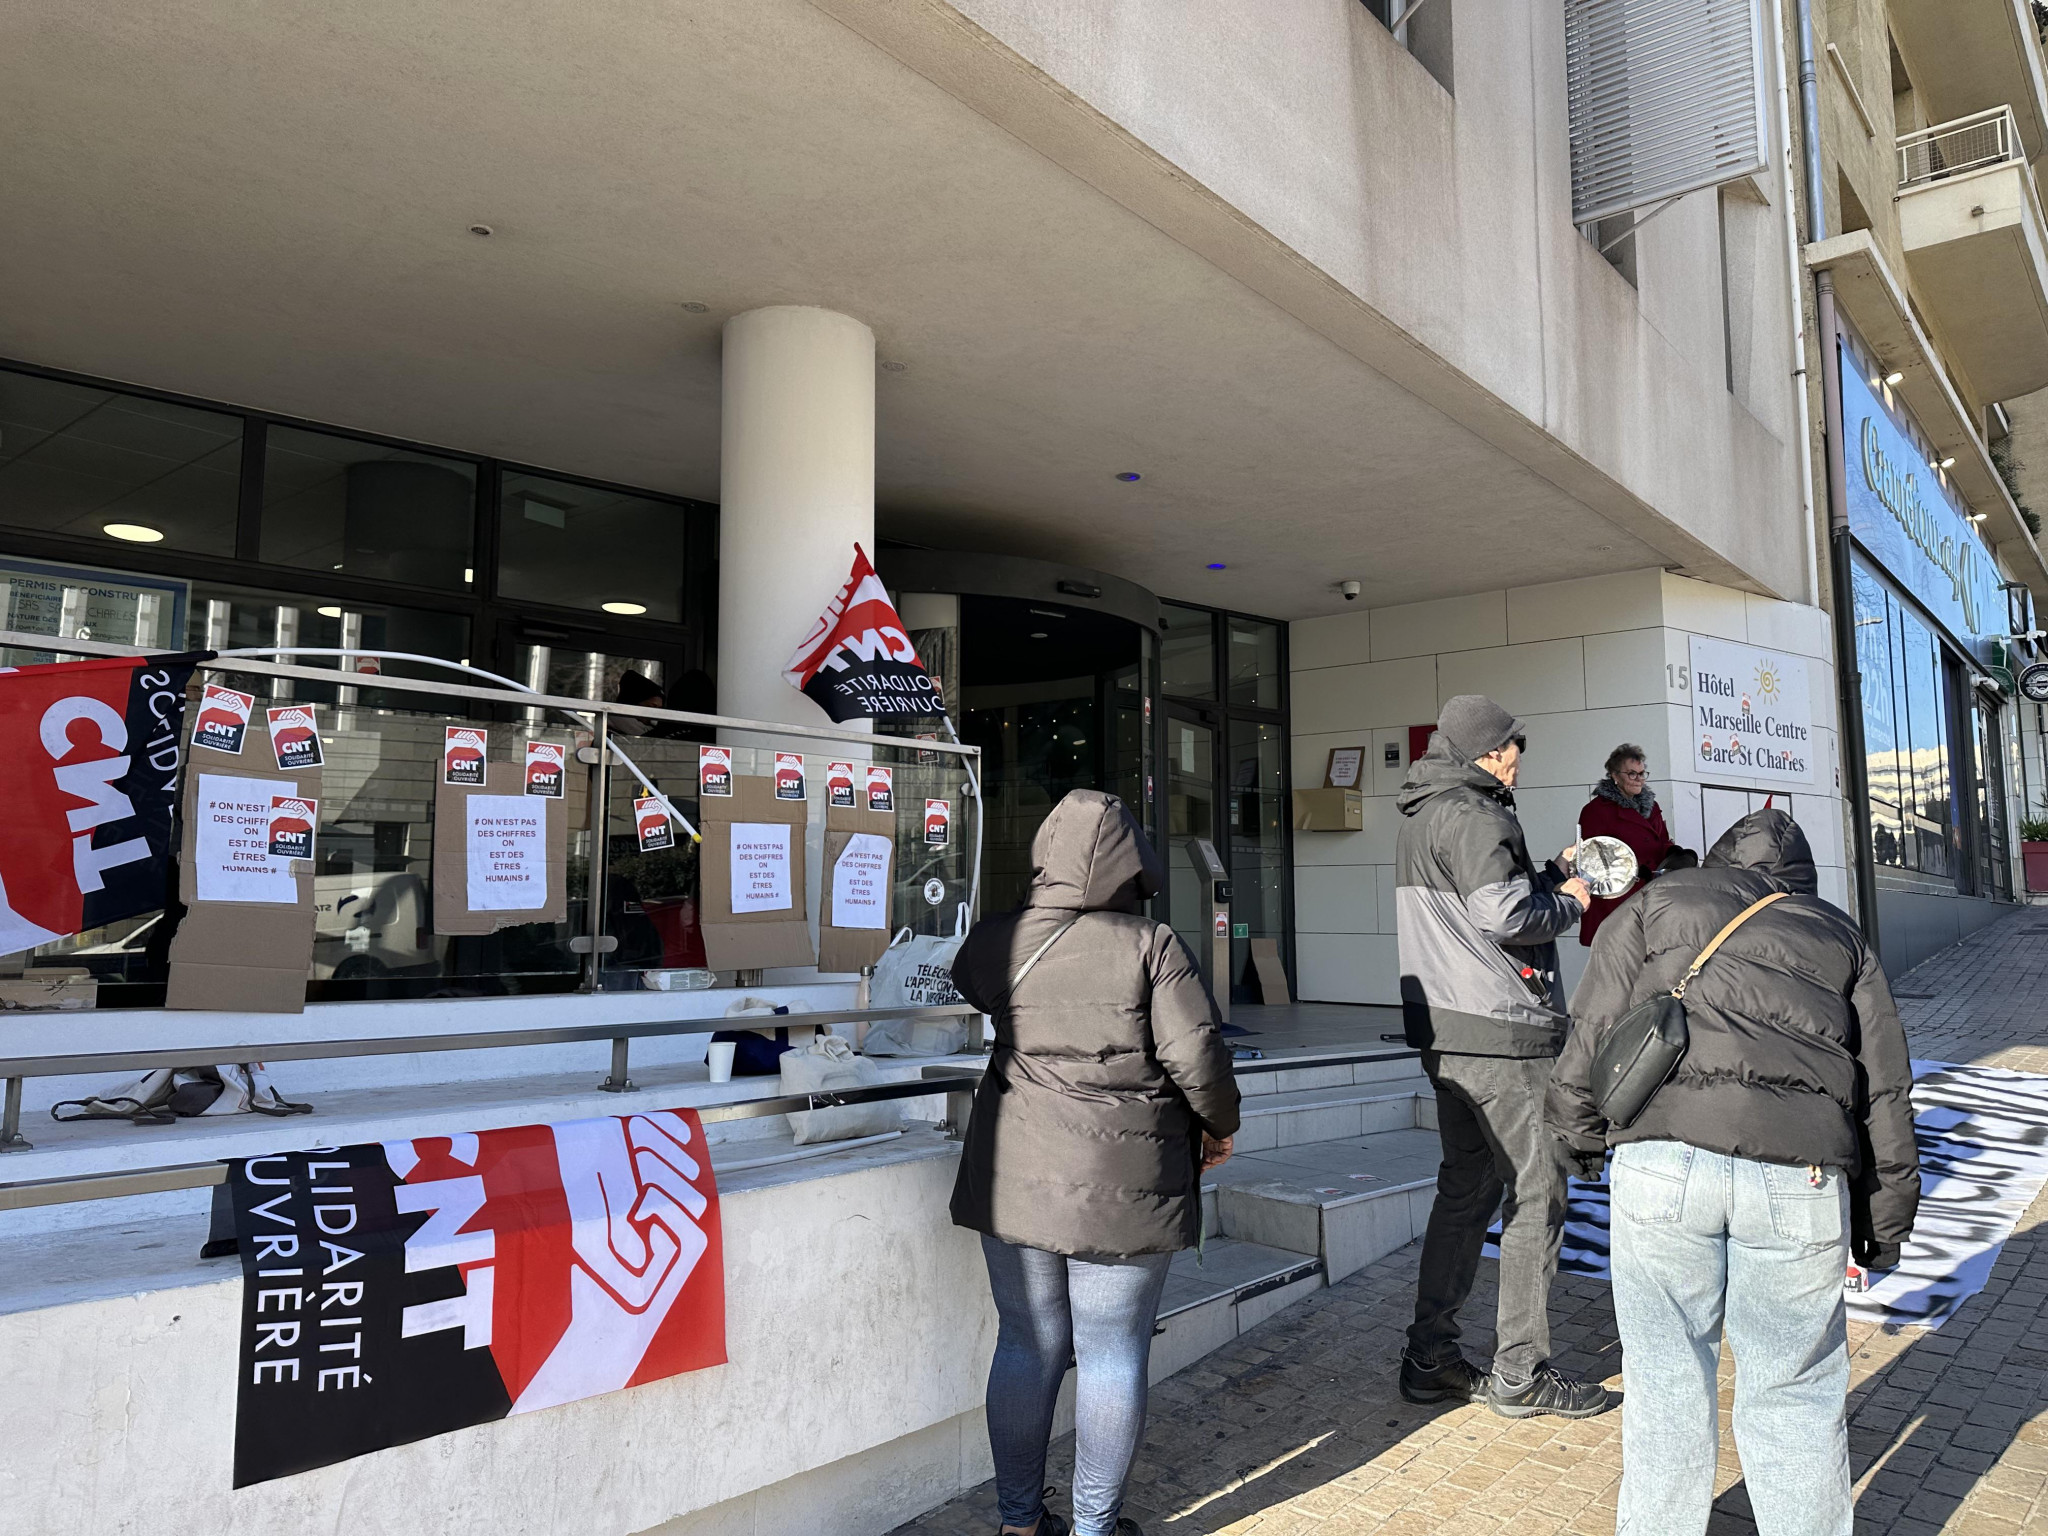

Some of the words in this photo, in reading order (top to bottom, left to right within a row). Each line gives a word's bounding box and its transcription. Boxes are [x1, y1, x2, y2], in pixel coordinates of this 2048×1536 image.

[9, 577, 56, 591] PERMIS
[80, 586, 157, 603] CONSTRURE
[7, 612, 41, 621] NATURE
[87, 607, 136, 621] CHARLES
[1666, 663, 1689, 690] 15
[1697, 672, 1735, 697] Hôtel
[1699, 705, 1761, 734] Marseille
[1765, 716, 1807, 740] Centre
[204, 721, 237, 738] CNT
[282, 740, 312, 754] CNT
[1739, 744, 1752, 766] St
[452, 759, 479, 771] CNT
[532, 772, 557, 785] CNT
[705, 773, 727, 784] CNT
[780, 778, 799, 789] CNT
[833, 786, 851, 796] CNT
[871, 791, 889, 800] CNT
[218, 802, 234, 810] ON
[236, 802, 266, 812] N'EST
[213, 814, 234, 823] DES
[237, 816, 269, 826] CHIFF
[481, 818, 493, 826] ON
[495, 818, 519, 826] N'EST
[521, 818, 537, 826] PAS
[243, 827, 259, 835] ON
[644, 825, 666, 837] CNT
[928, 823, 945, 833] CNT
[228, 839, 248, 848] EST
[275, 831, 306, 844] CNT
[233, 851, 266, 861] ÊTRES
[222, 865, 269, 873] HUMAINS
[493, 861, 521, 870] ÊTRES
[752, 880, 772, 889] ÊTRES
[851, 887, 871, 895] ÊTRES
[910, 990, 922, 1002] LA
[380, 1133, 496, 1351] CNT
[244, 1156, 317, 1385] UVRIÈRE
[306, 1146, 372, 1391] LIDARITÉ
